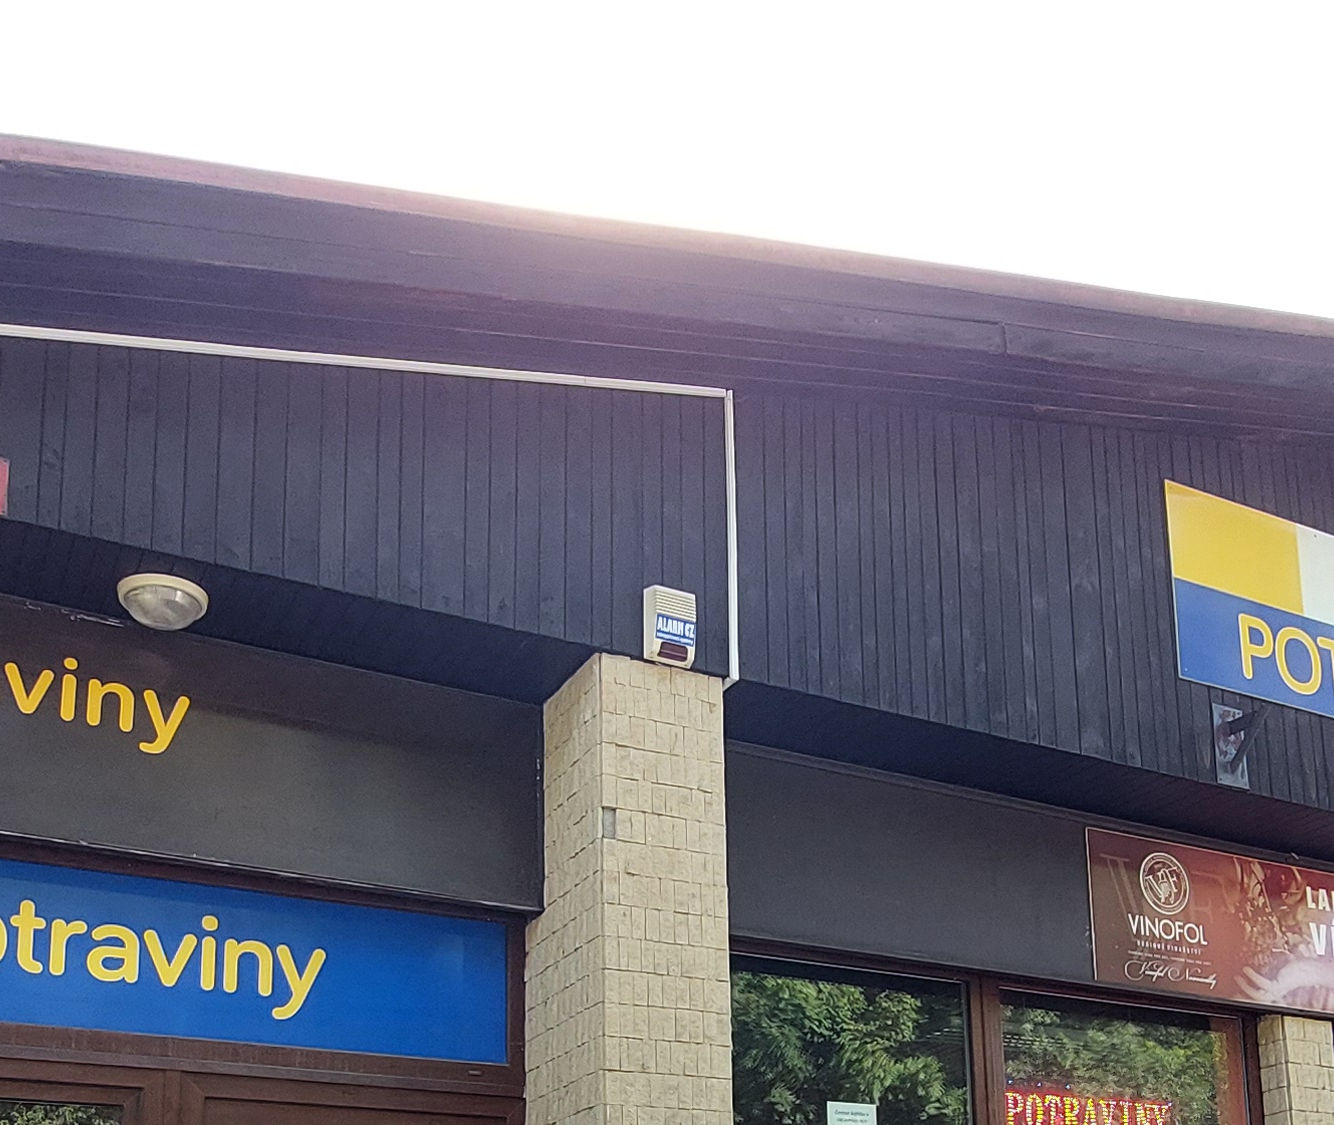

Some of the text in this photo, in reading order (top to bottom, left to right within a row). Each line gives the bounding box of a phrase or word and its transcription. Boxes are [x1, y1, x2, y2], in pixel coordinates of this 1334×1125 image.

[657, 616, 695, 639] ALARM CZ
[1128, 913, 1208, 945] VINOFOL
